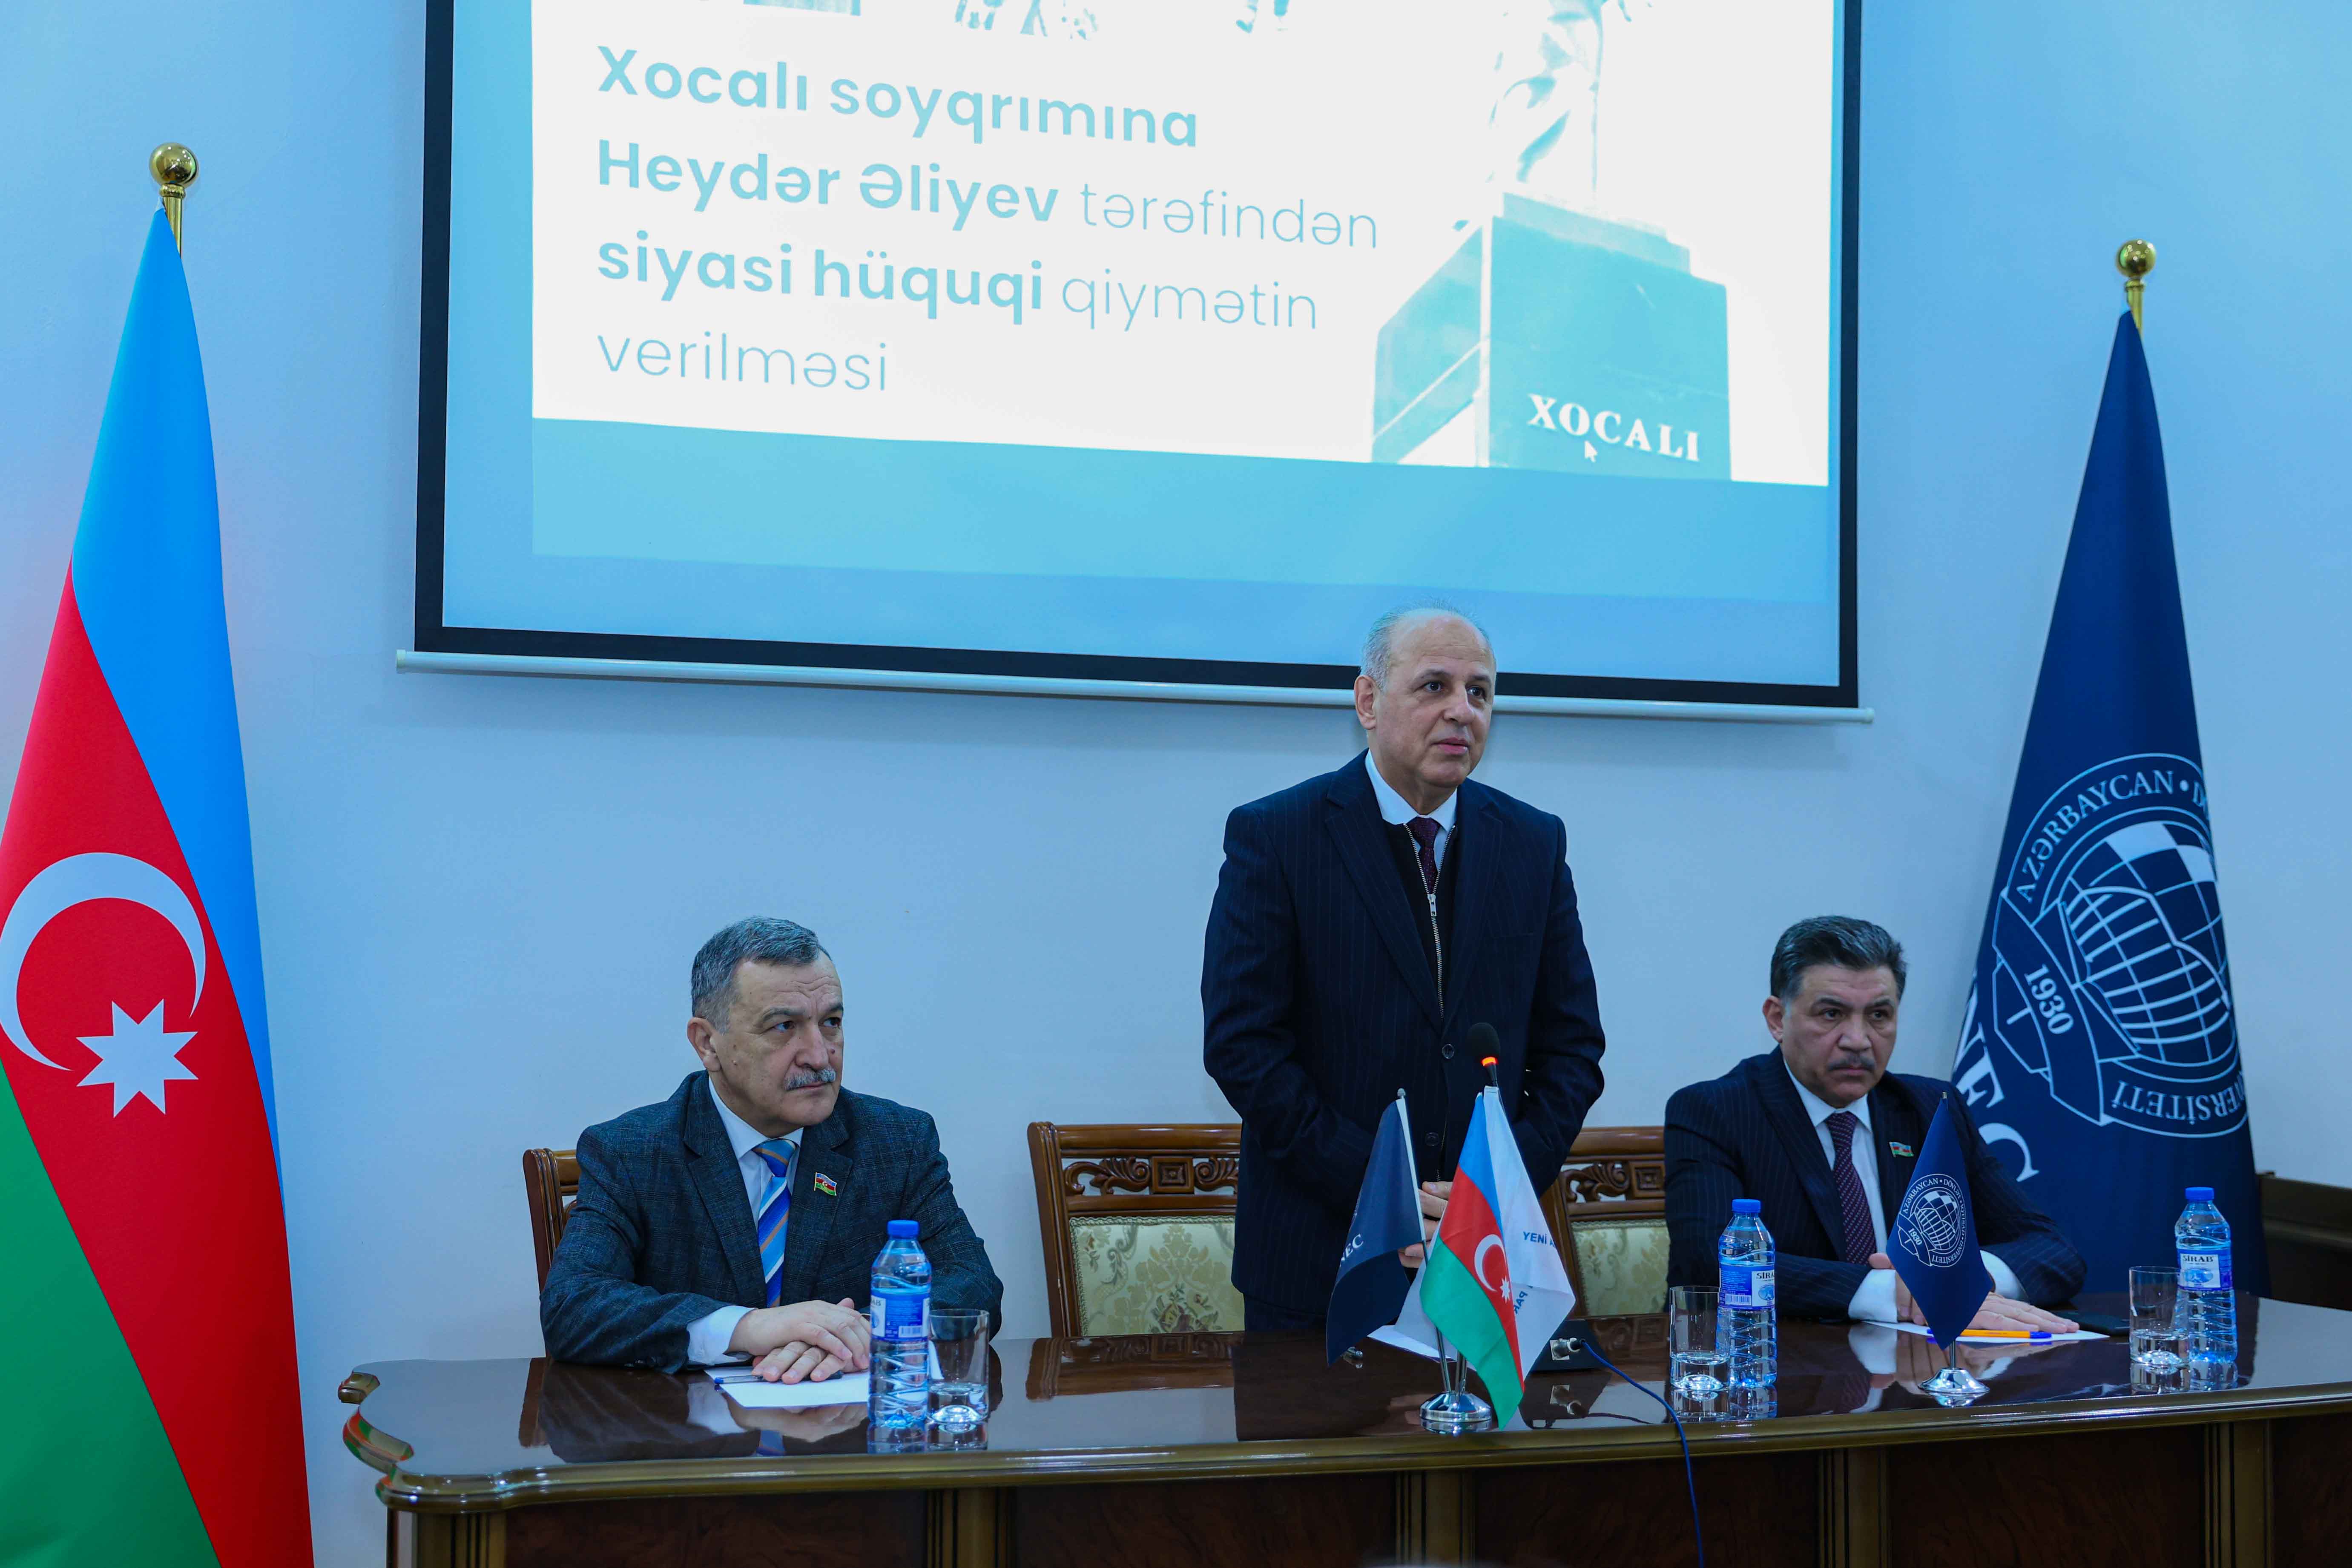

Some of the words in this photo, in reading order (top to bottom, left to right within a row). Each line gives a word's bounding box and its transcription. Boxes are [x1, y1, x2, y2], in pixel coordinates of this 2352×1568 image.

[597, 46, 807, 112] Xocalı
[830, 78, 1196, 147] soyqrımına
[599, 139, 841, 213] Heydər
[859, 163, 1060, 232] Əliyev
[1080, 183, 1377, 249] tərəfindən
[597, 229, 792, 302] siyasi
[814, 248, 1042, 326] hüquqi
[1062, 268, 1316, 332] qiymətin
[597, 330, 886, 391] verilməsi
[1528, 393, 1699, 461] XOCALI
[2016, 770, 2173, 903] AZƏRBAYCAN
[2025, 964, 2074, 1034] 1930
[1903, 1178, 1938, 1214] AZƏRBAYCAN
[1523, 1232, 1547, 1245] YENİ
[1908, 1228, 1922, 1245] 1930
